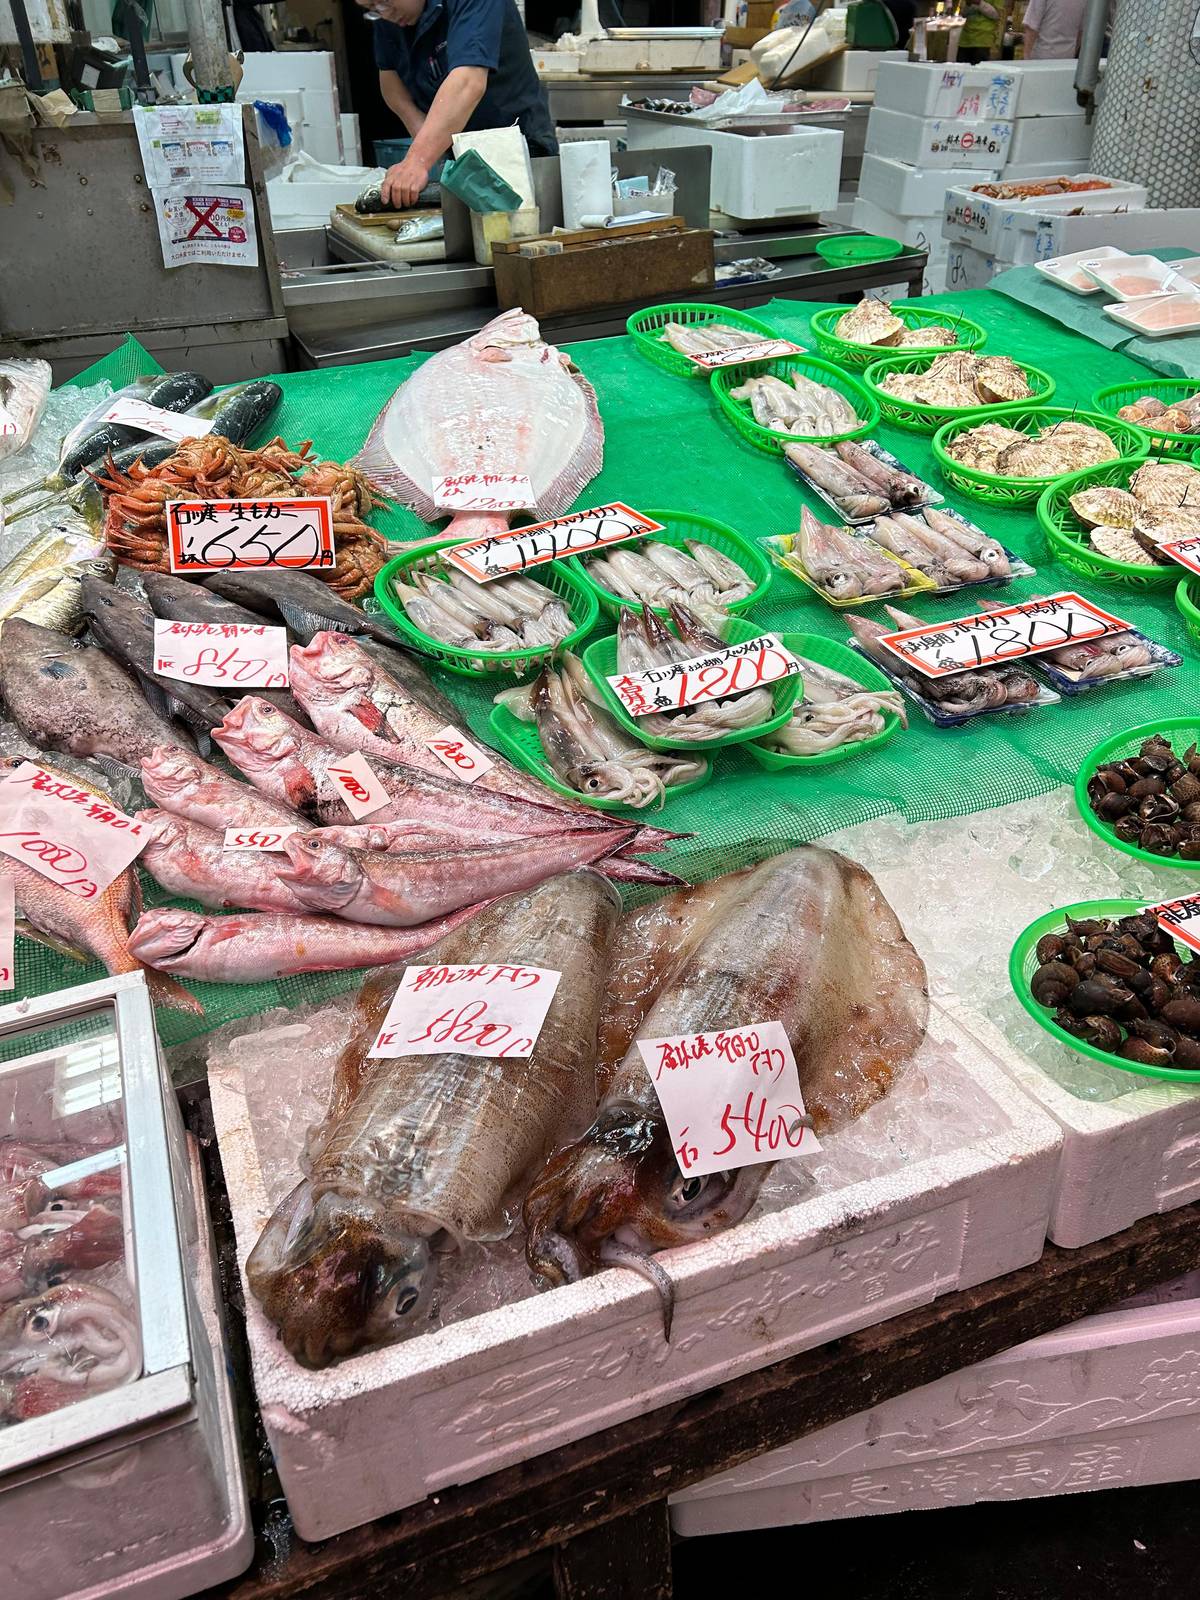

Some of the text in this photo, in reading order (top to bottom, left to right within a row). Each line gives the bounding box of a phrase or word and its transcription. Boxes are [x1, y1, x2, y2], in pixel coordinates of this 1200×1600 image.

[553, 506, 618, 530] スルメイカ
[634, 523, 652, 536] 円
[202, 524, 320, 569] 650
[319, 550, 334, 567] 円
[720, 638, 775, 661] スルメイカ
[785, 662, 800, 675] 円
[225, 831, 282, 848] 550
[713, 1091, 804, 1156] 5400
